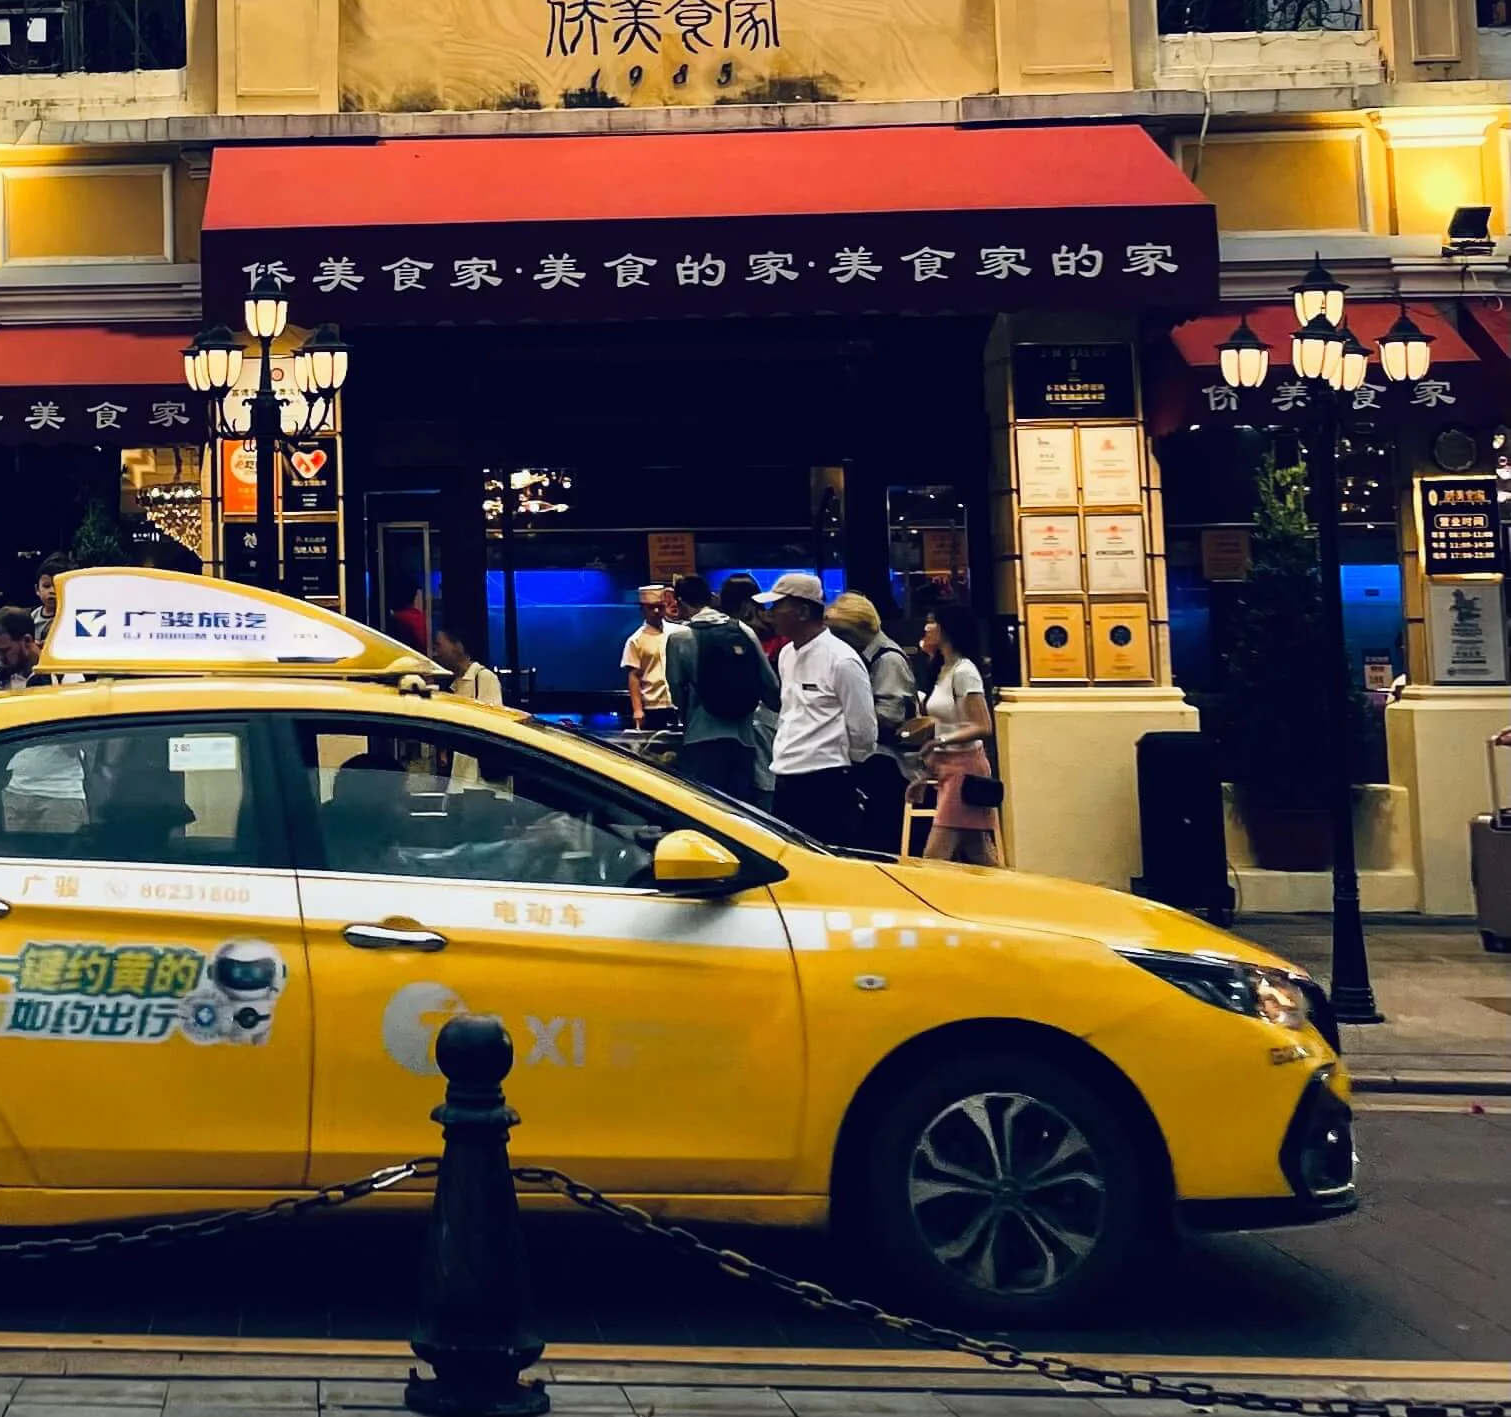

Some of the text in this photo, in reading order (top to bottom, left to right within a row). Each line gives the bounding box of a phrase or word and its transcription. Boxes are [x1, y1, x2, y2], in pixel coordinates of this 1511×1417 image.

[589, 61, 733, 89] 1985
[1201, 379, 1457, 412] 侨美食家
[21, 874, 80, 899] 广骏
[493, 899, 586, 929] 电动车
